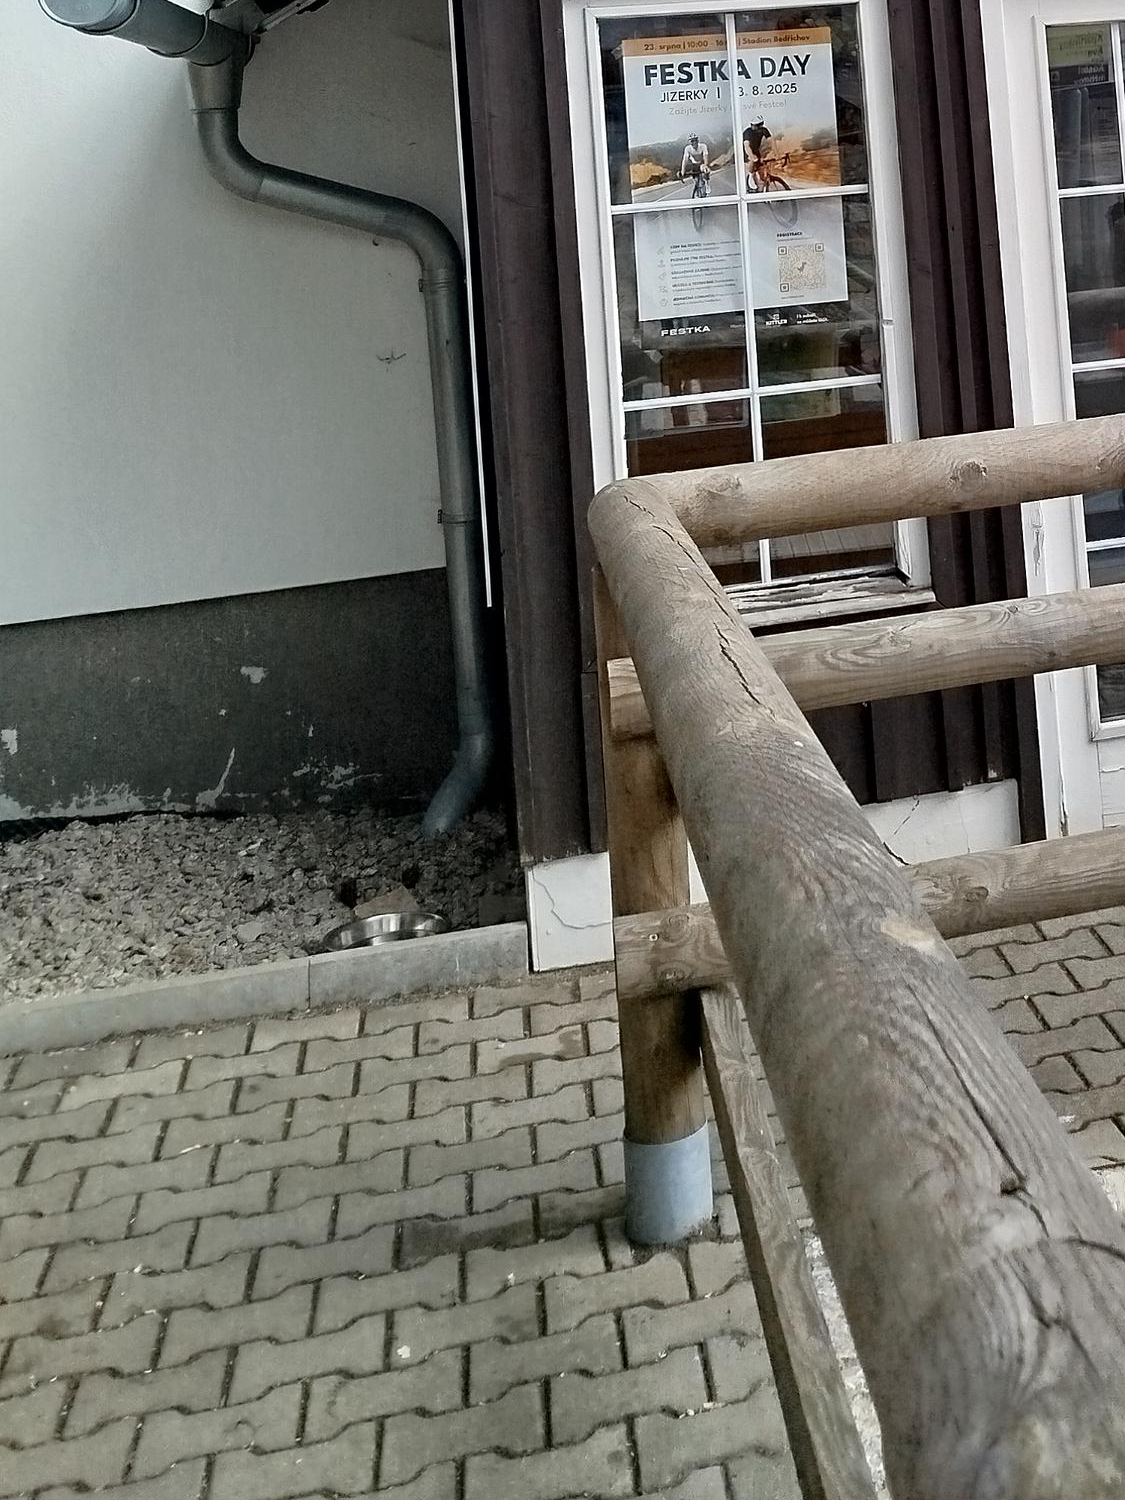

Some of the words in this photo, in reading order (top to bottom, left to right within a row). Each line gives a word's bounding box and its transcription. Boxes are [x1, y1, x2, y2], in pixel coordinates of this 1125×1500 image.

[659, 44, 681, 52] srpna
[687, 40, 709, 48] 10:00
[742, 36, 772, 45] Stadion
[773, 33, 811, 43] Bedřichov
[643, 59, 752, 87] FESTKA
[760, 54, 812, 79] DAY
[660, 89, 709, 103] JIZERKY
[752, 85, 763, 96] 8.
[767, 82, 798, 95] 2025
[700, 104, 728, 115] Jizerky
[660, 325, 711, 337] FESTKA
